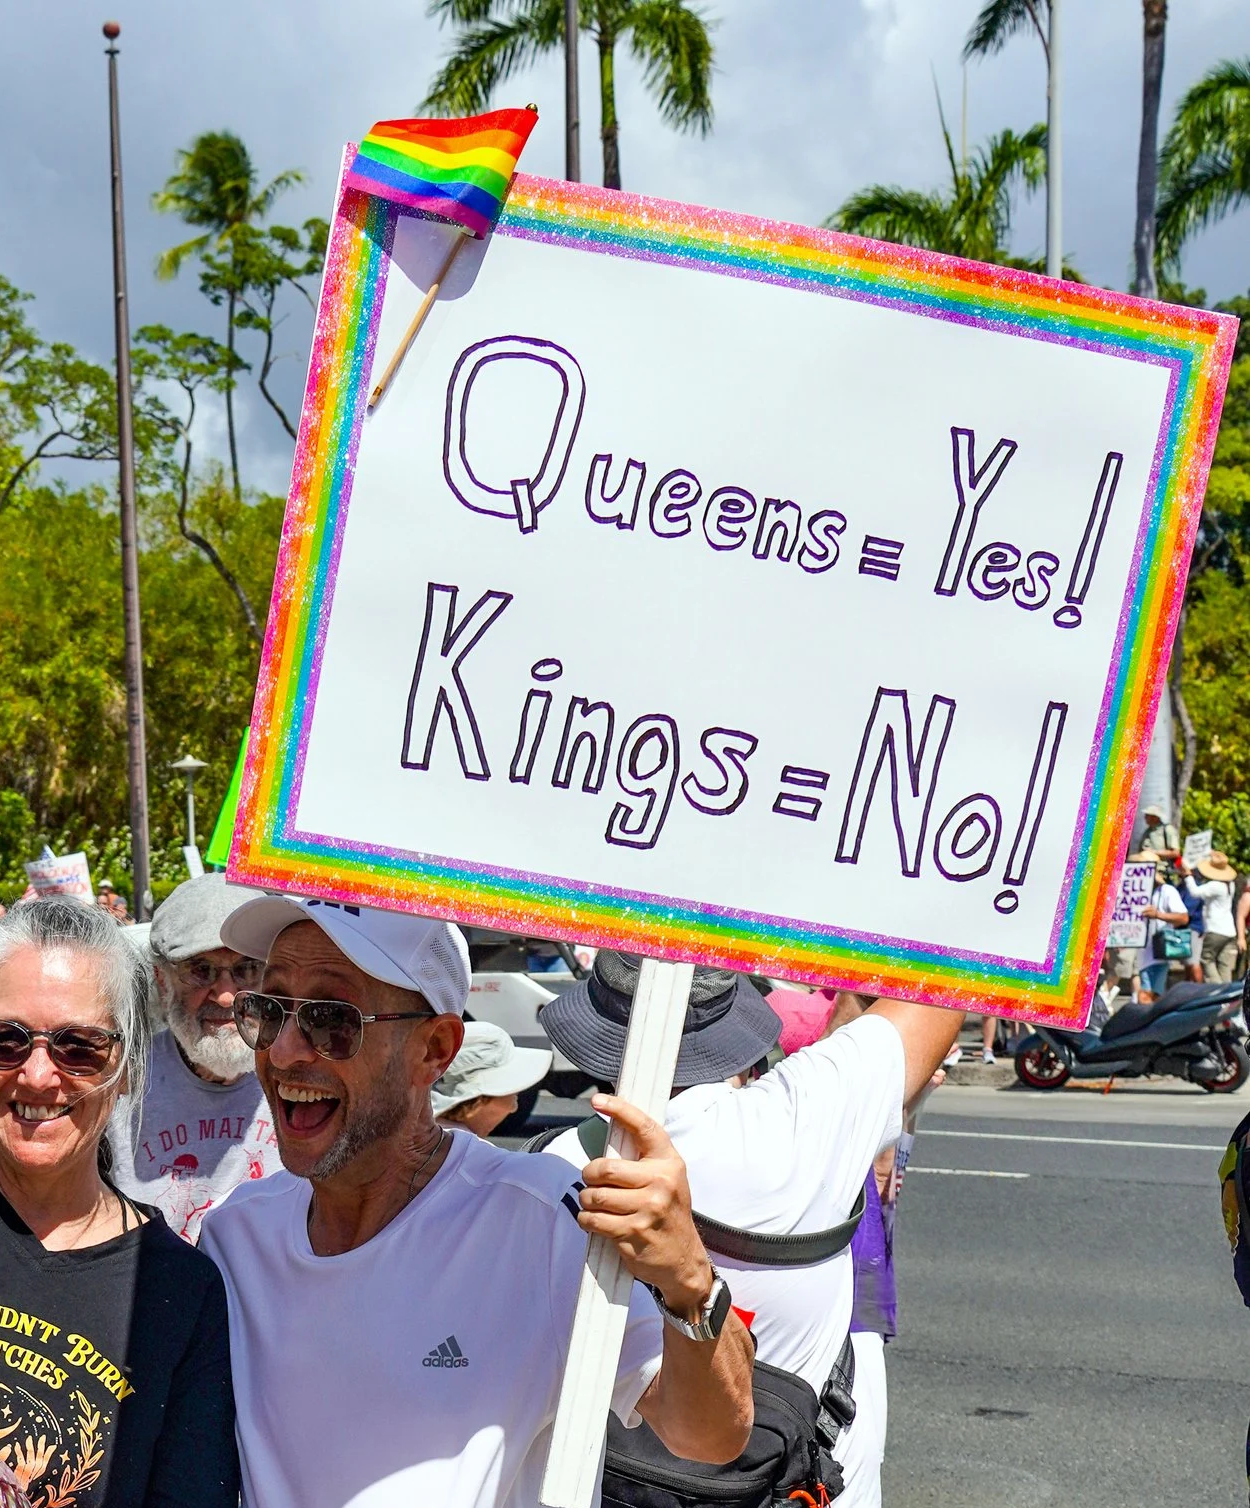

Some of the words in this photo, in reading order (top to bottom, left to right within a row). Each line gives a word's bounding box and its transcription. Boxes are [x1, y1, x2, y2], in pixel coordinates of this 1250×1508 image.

[442, 335, 847, 574] Queens
[935, 425, 1124, 629] Yes!
[400, 581, 759, 850] Kings
[833, 686, 1069, 916] No!
[1122, 880, 1145, 895] ELL
[1111, 908, 1145, 922] RUTH
[142, 1141, 156, 1162] I
[158, 1123, 188, 1152] DO
[198, 1117, 245, 1141] MAI
[255, 1119, 278, 1149] TA
[61, 1333, 137, 1404] BURN
[421, 1355, 470, 1369] adidas
